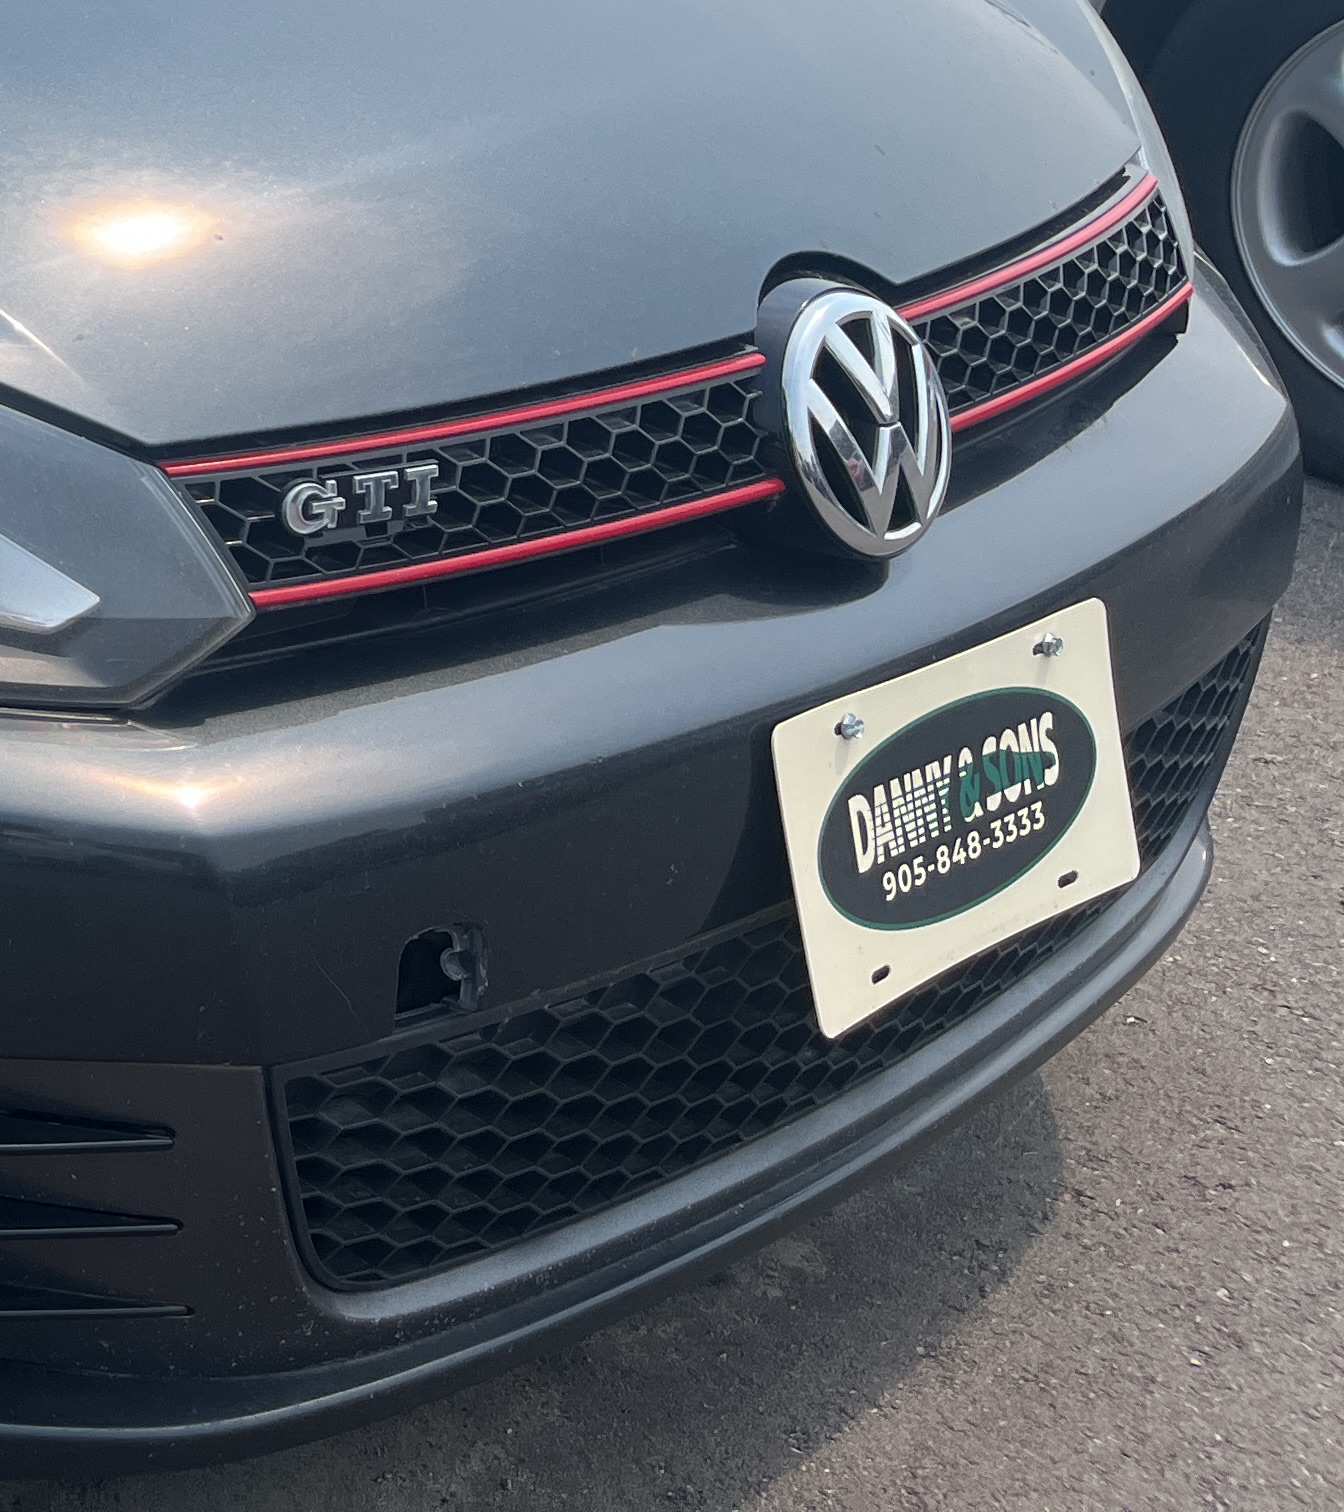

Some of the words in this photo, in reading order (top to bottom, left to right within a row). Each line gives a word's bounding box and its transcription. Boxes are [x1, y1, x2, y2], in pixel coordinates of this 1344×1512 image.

[282, 459, 440, 537] GTI
[847, 754, 953, 875] DANNY
[957, 746, 984, 824] &
[980, 710, 1060, 810] SONS
[881, 800, 1046, 902] 905-848-3333
